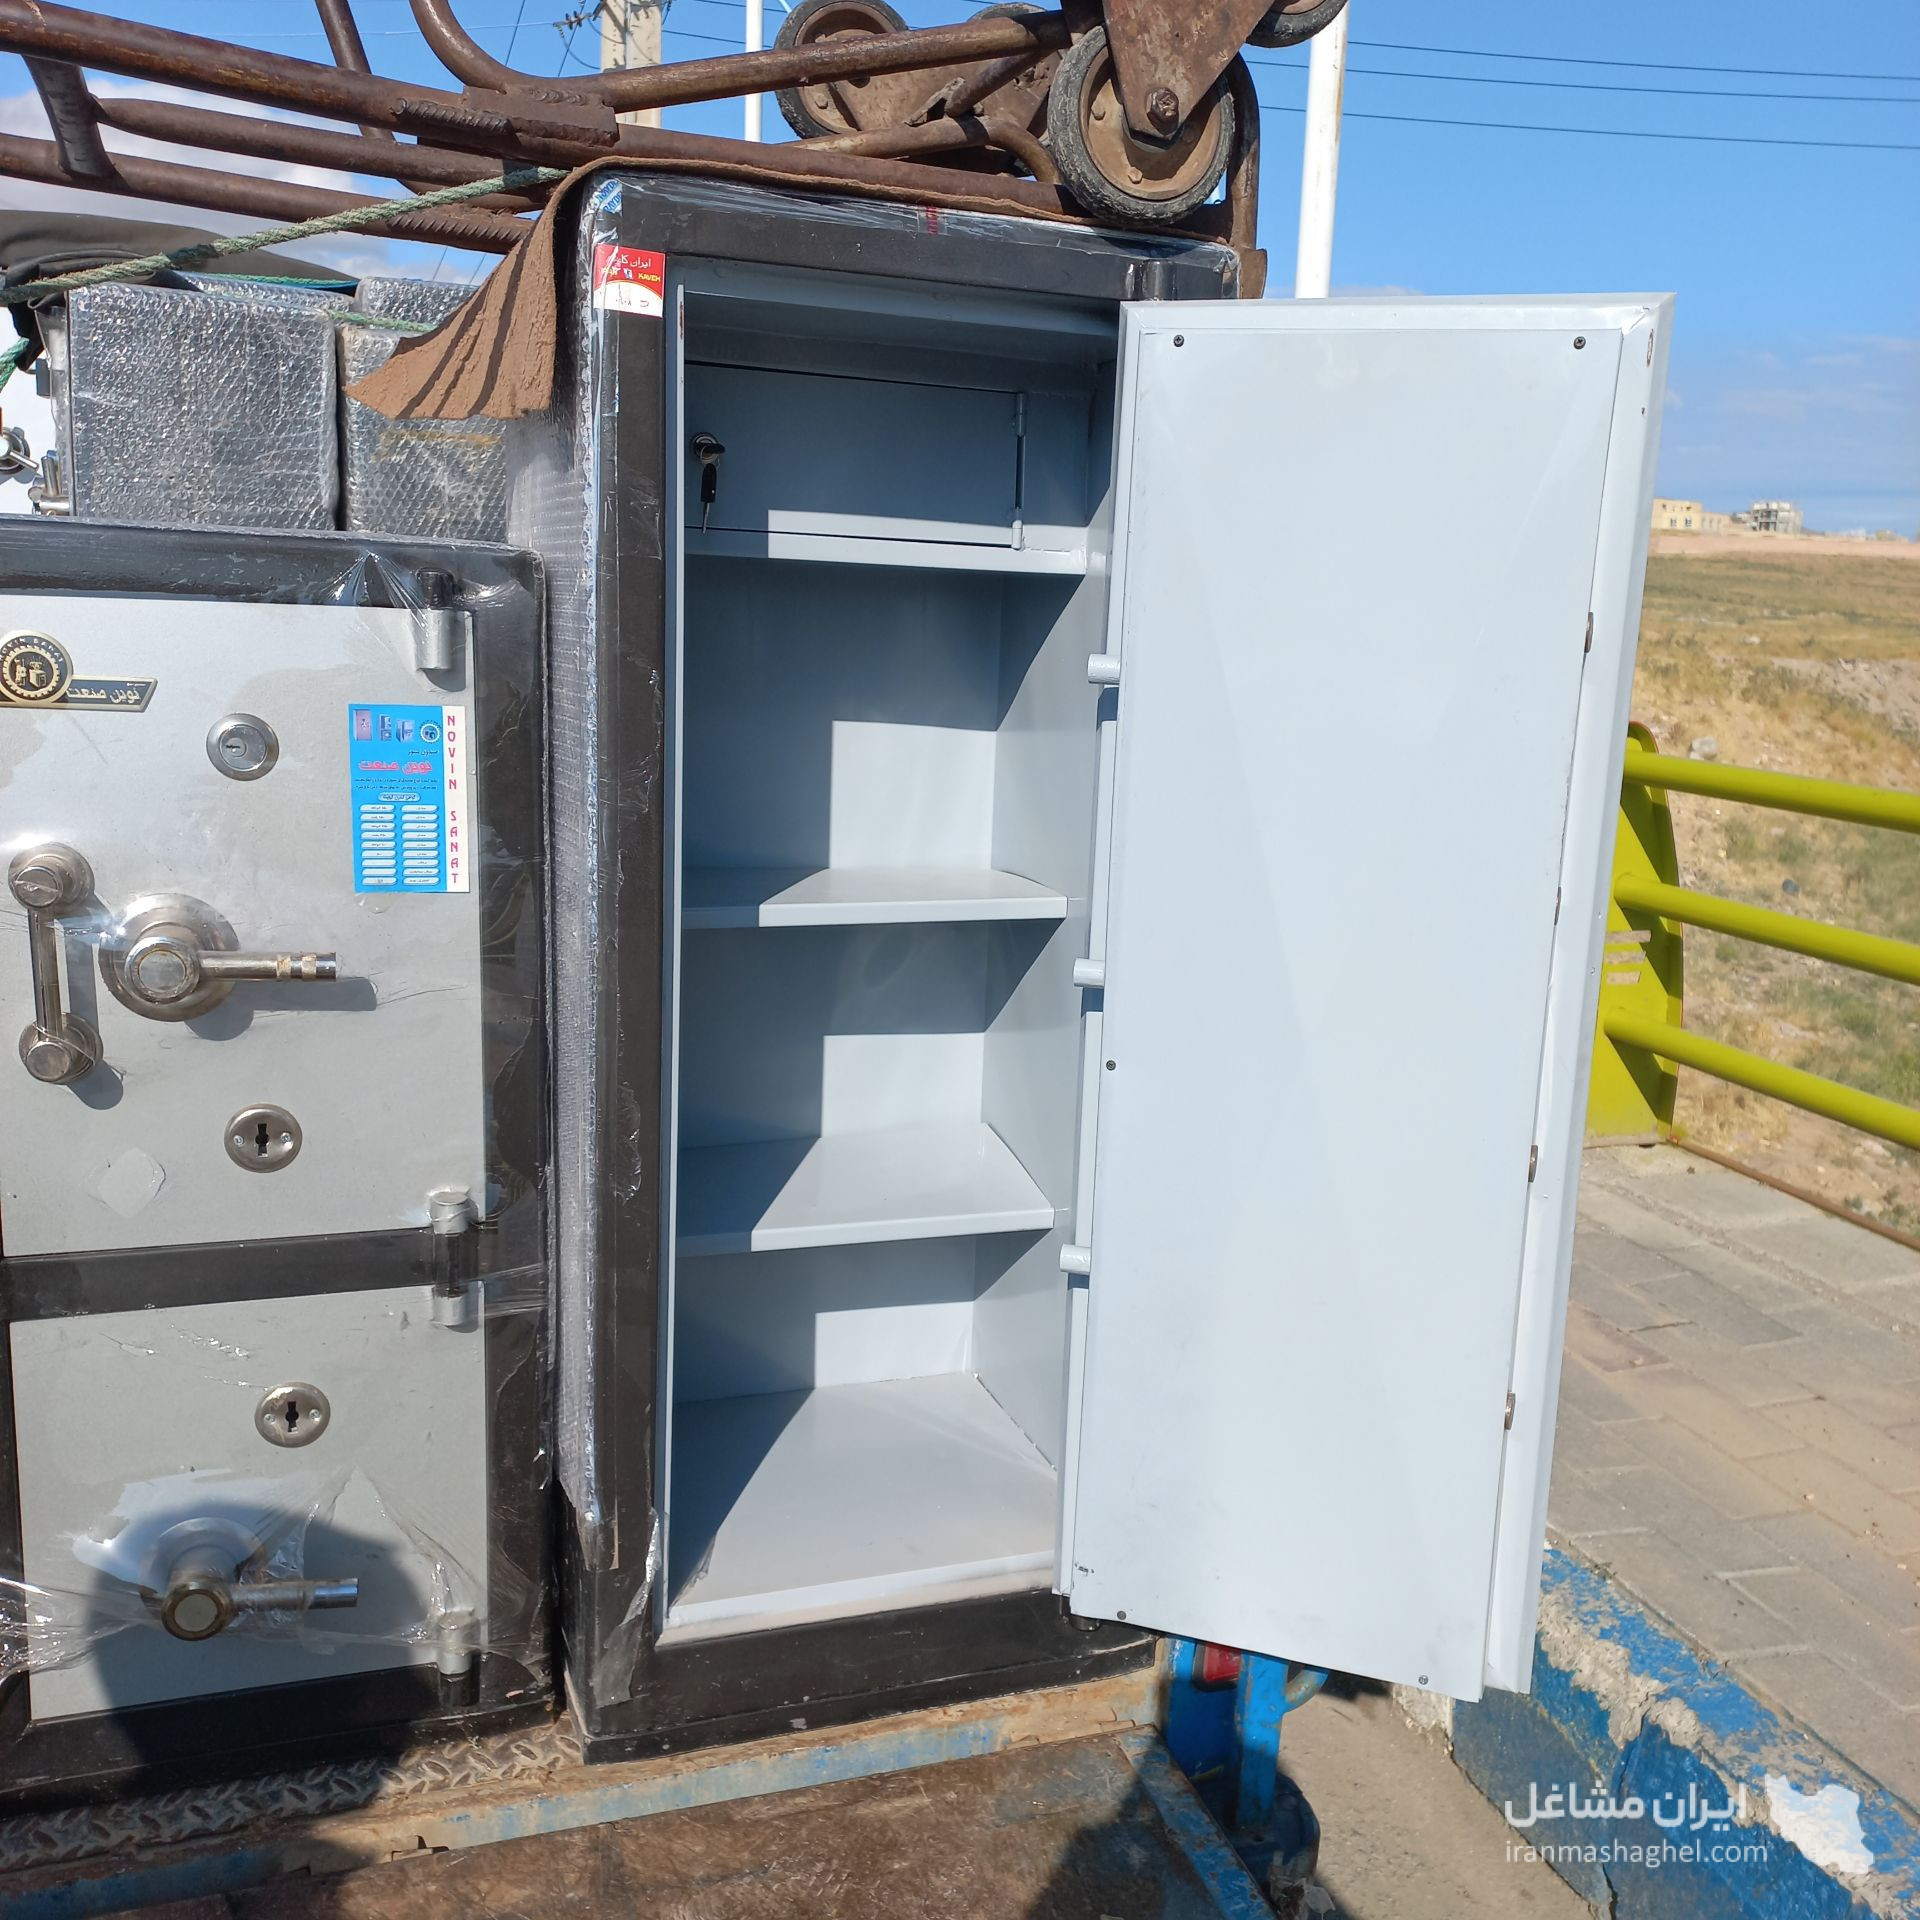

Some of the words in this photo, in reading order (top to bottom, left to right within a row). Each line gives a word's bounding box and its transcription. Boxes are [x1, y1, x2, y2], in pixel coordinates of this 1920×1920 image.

[630, 256, 652, 269] ایران
[638, 272, 661, 282] KAVEH
[66, 687, 107, 699] صنعت
[110, 687, 141, 704] نوین
[447, 715, 457, 790] NOVIN
[359, 760, 400, 772] صنعت
[402, 761, 433, 775] نوین
[450, 811, 459, 884] SANAT
